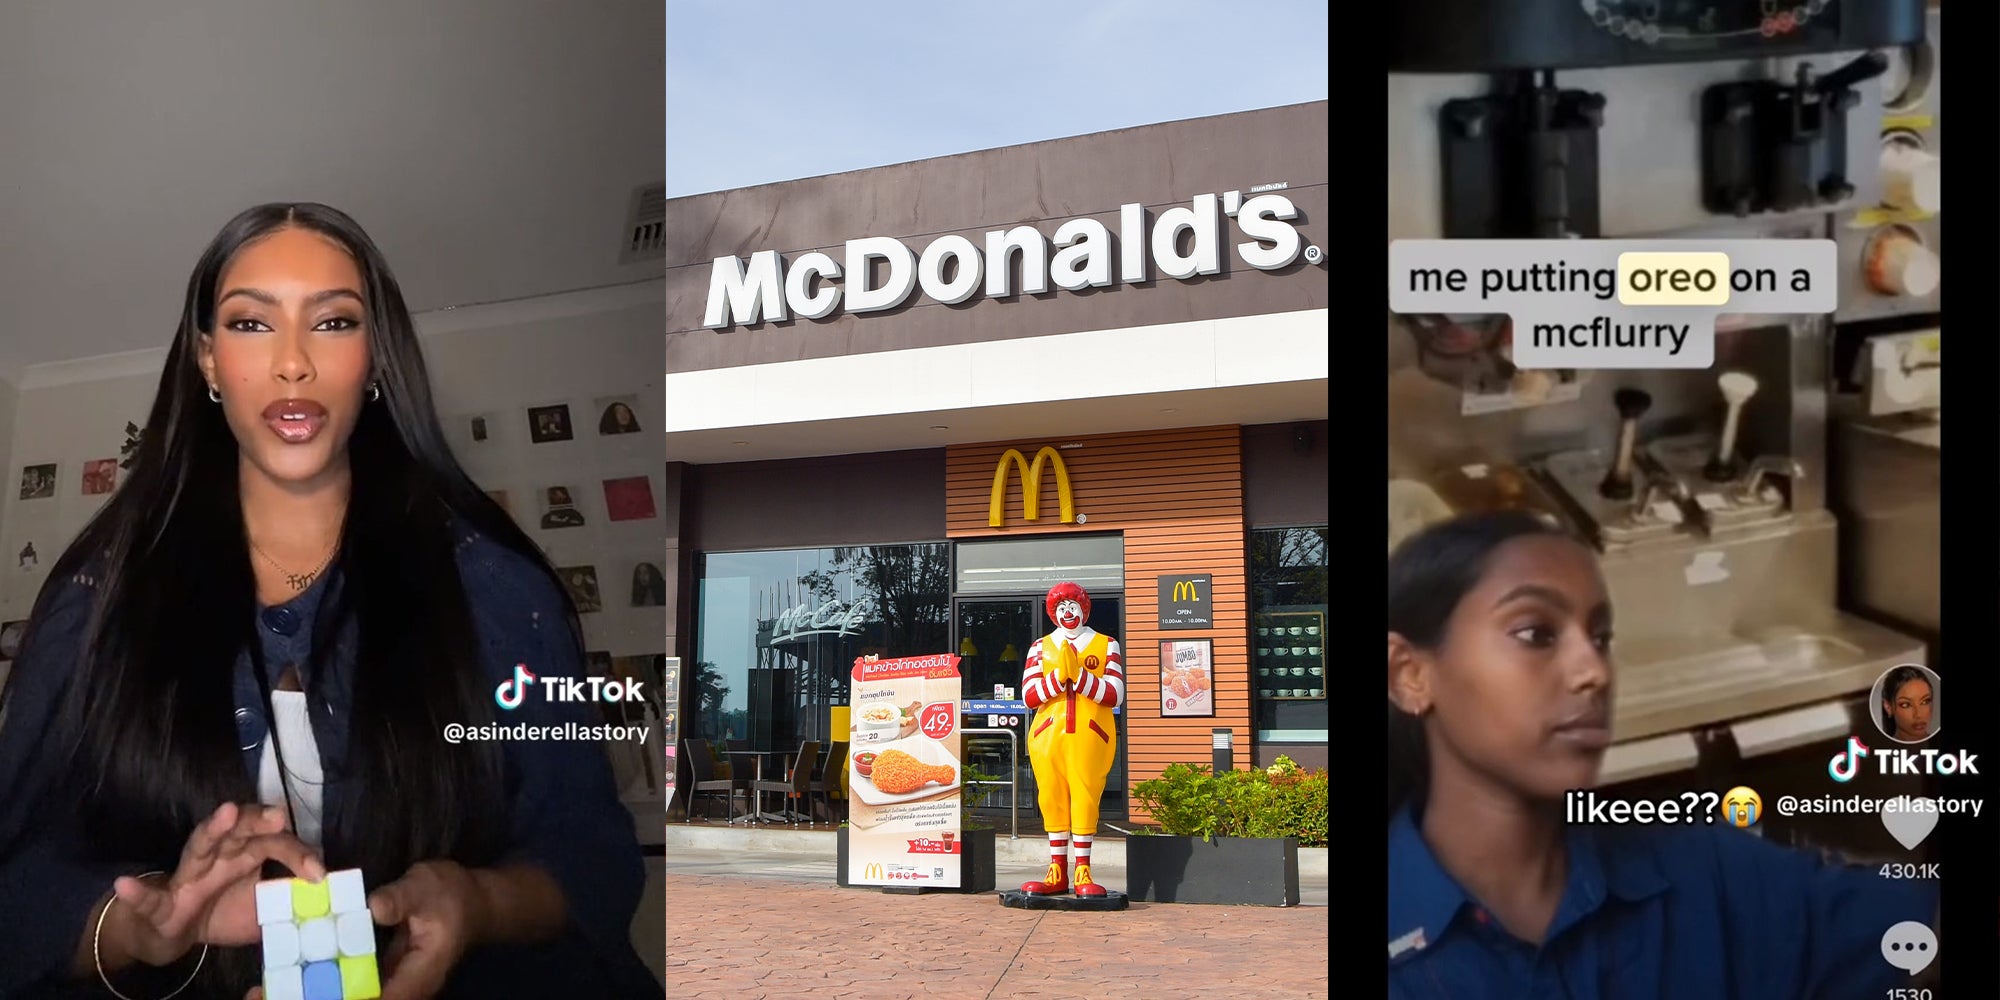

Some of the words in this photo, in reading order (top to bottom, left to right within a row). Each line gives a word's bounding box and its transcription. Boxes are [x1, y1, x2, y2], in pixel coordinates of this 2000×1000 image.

[703, 191, 1301, 330] McDonald's
[1176, 608, 1192, 616] OPEN
[868, 732, 879, 740] 20
